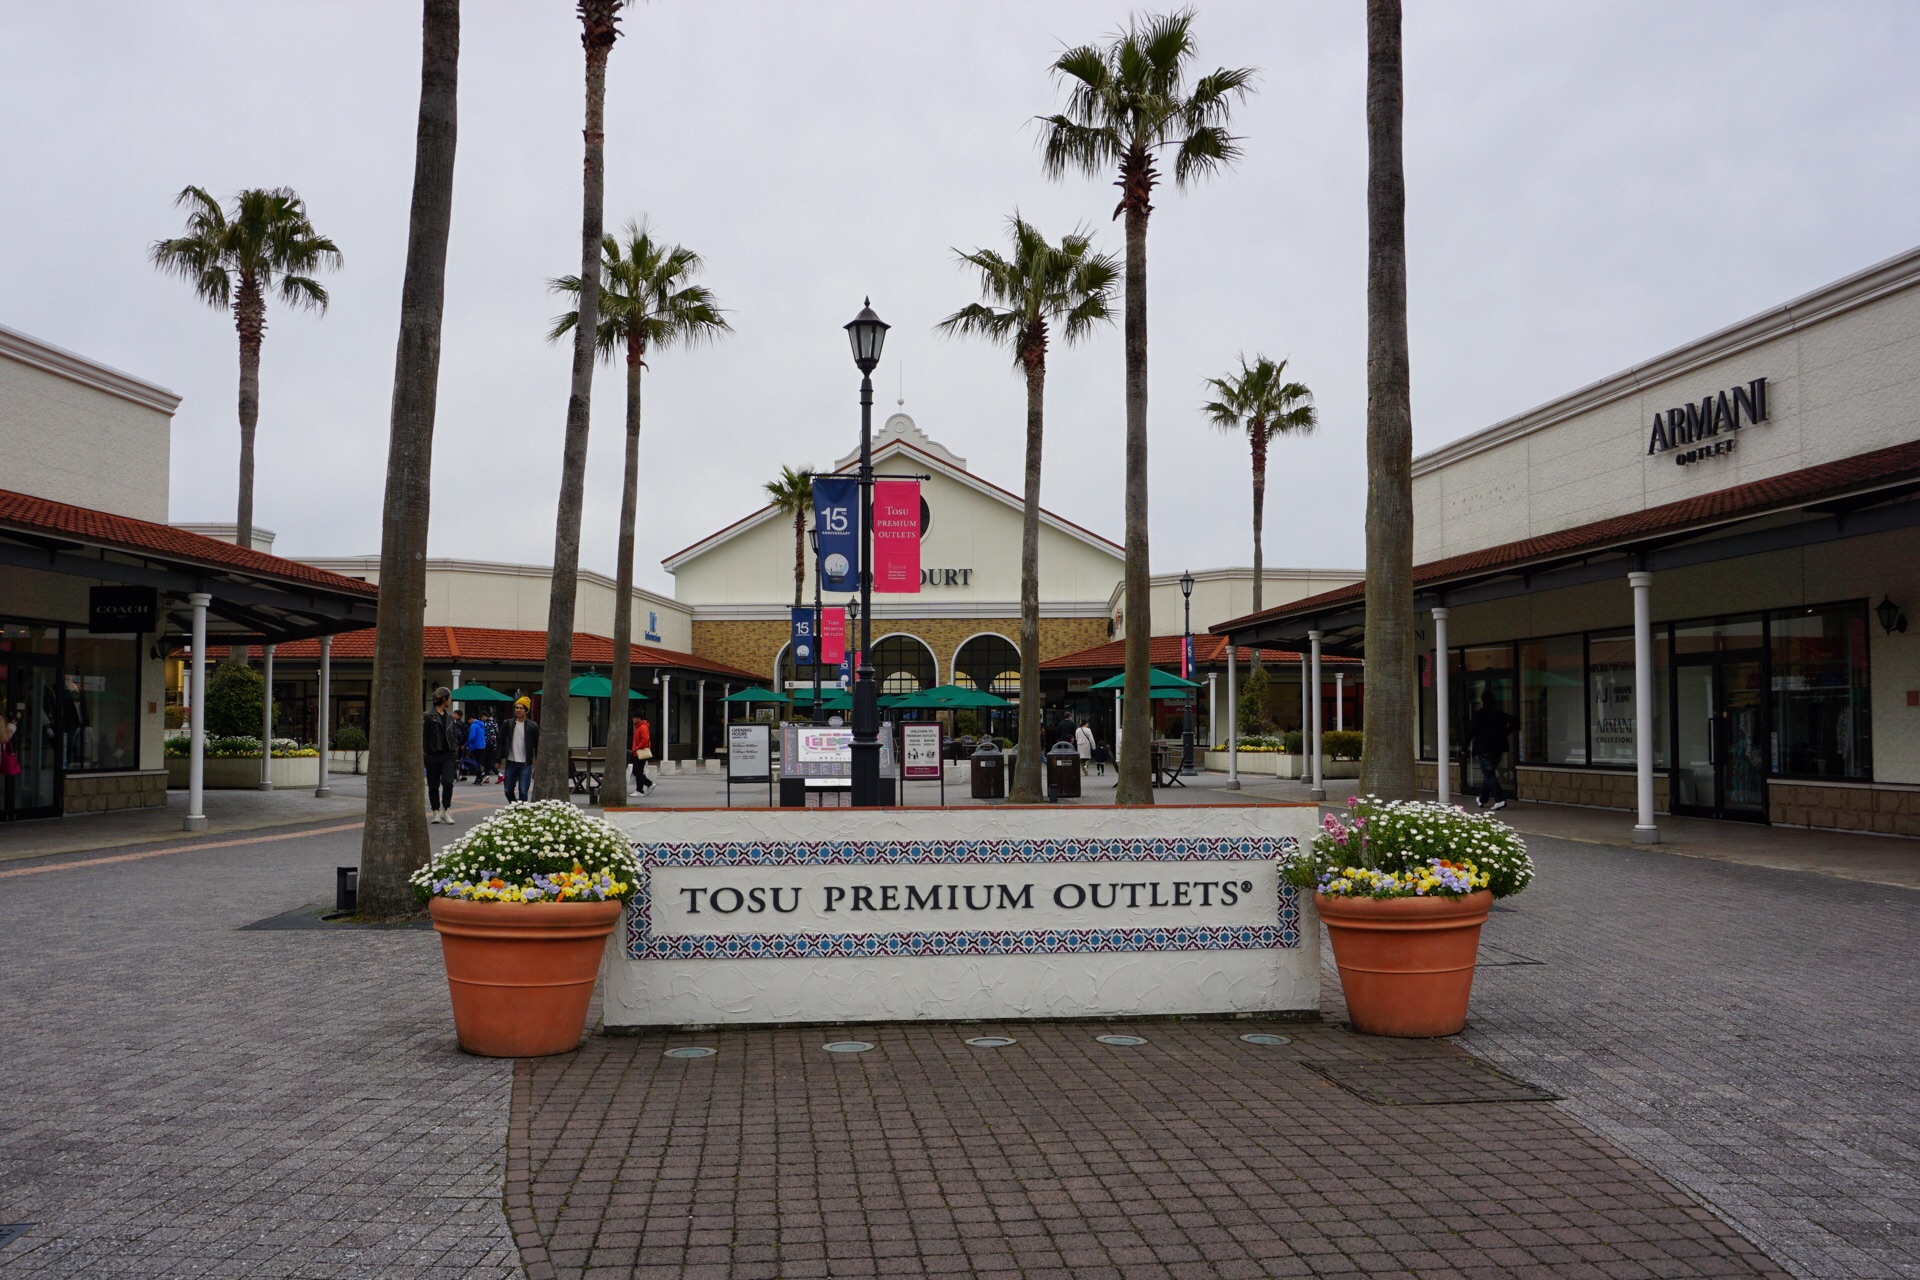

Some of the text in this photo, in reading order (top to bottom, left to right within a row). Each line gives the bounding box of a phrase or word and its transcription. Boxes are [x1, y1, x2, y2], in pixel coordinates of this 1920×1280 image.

[1647, 377, 1768, 455] ARMANI
[1676, 439, 1736, 466] OUTLET
[96, 605, 148, 614] COACH
[1595, 718, 1632, 734] ARMANI
[1595, 736, 1633, 744] COLLEZIONI
[680, 887, 802, 914] TOSU
[823, 883, 1034, 911] PREMIUM
